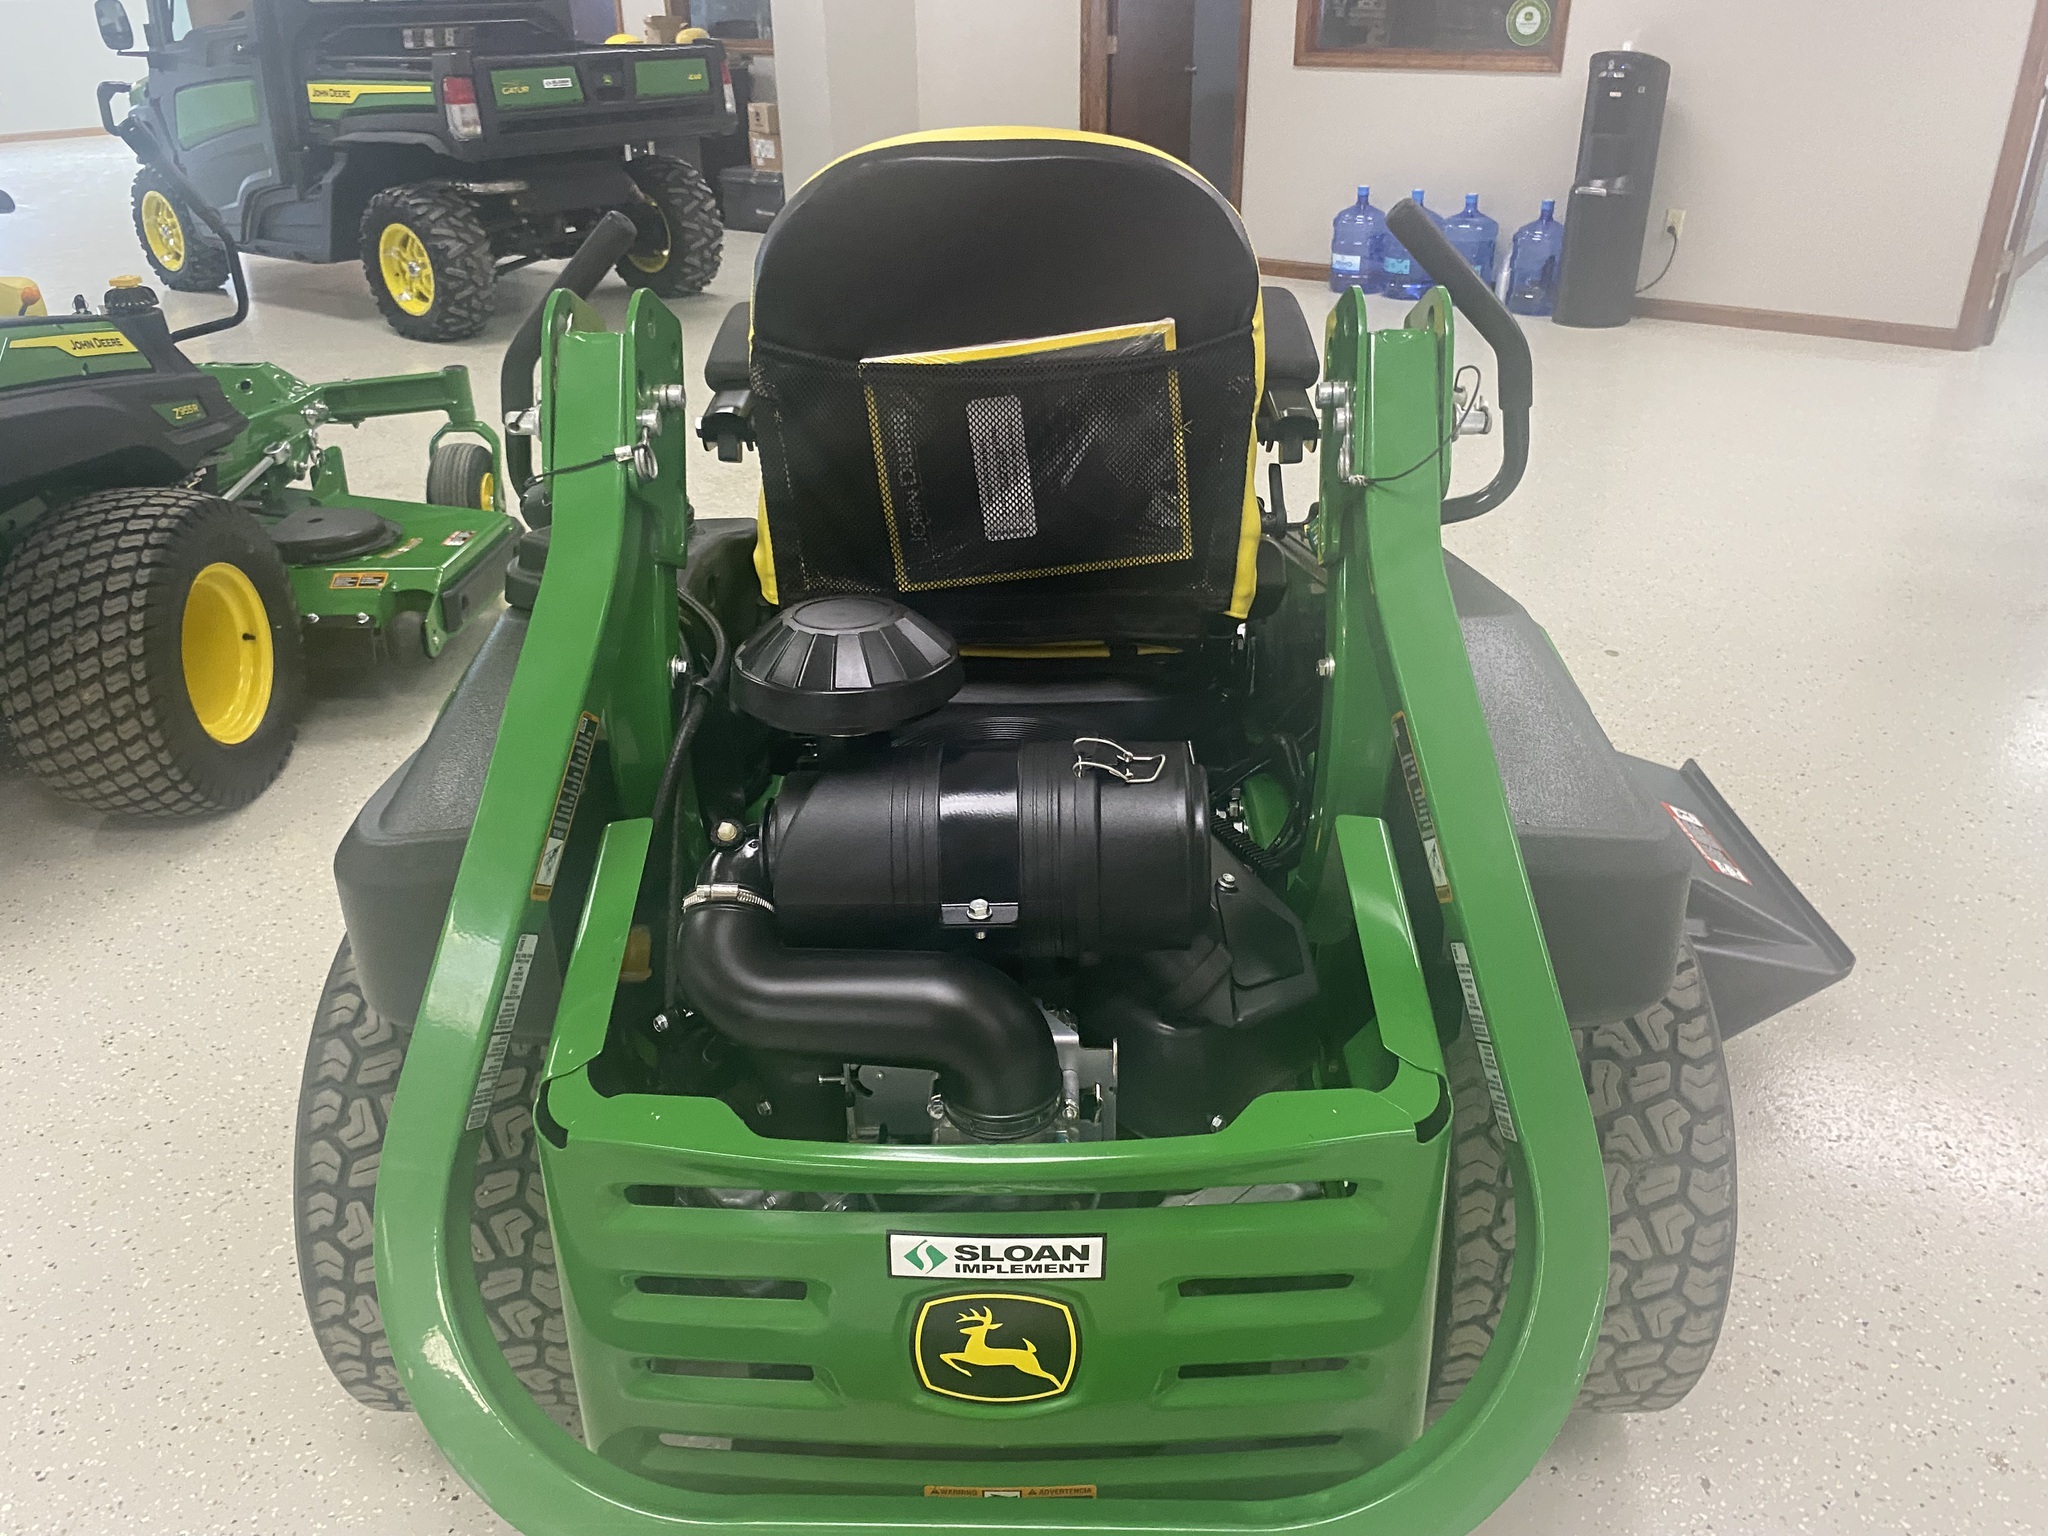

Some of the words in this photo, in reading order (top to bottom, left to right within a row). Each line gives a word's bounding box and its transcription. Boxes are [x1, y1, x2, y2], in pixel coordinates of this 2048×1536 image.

[312, 88, 329, 98] JOHN
[329, 88, 351, 99] DEERE
[70, 338, 94, 350] JOHN
[93, 337, 124, 348] DEERE
[171, 403, 199, 420] Z955R
[954, 1244, 1090, 1262] SLOAN
[954, 1263, 1090, 1274] IMPLEMENT
[1037, 1487, 1092, 1496] ADVERTENCIA
